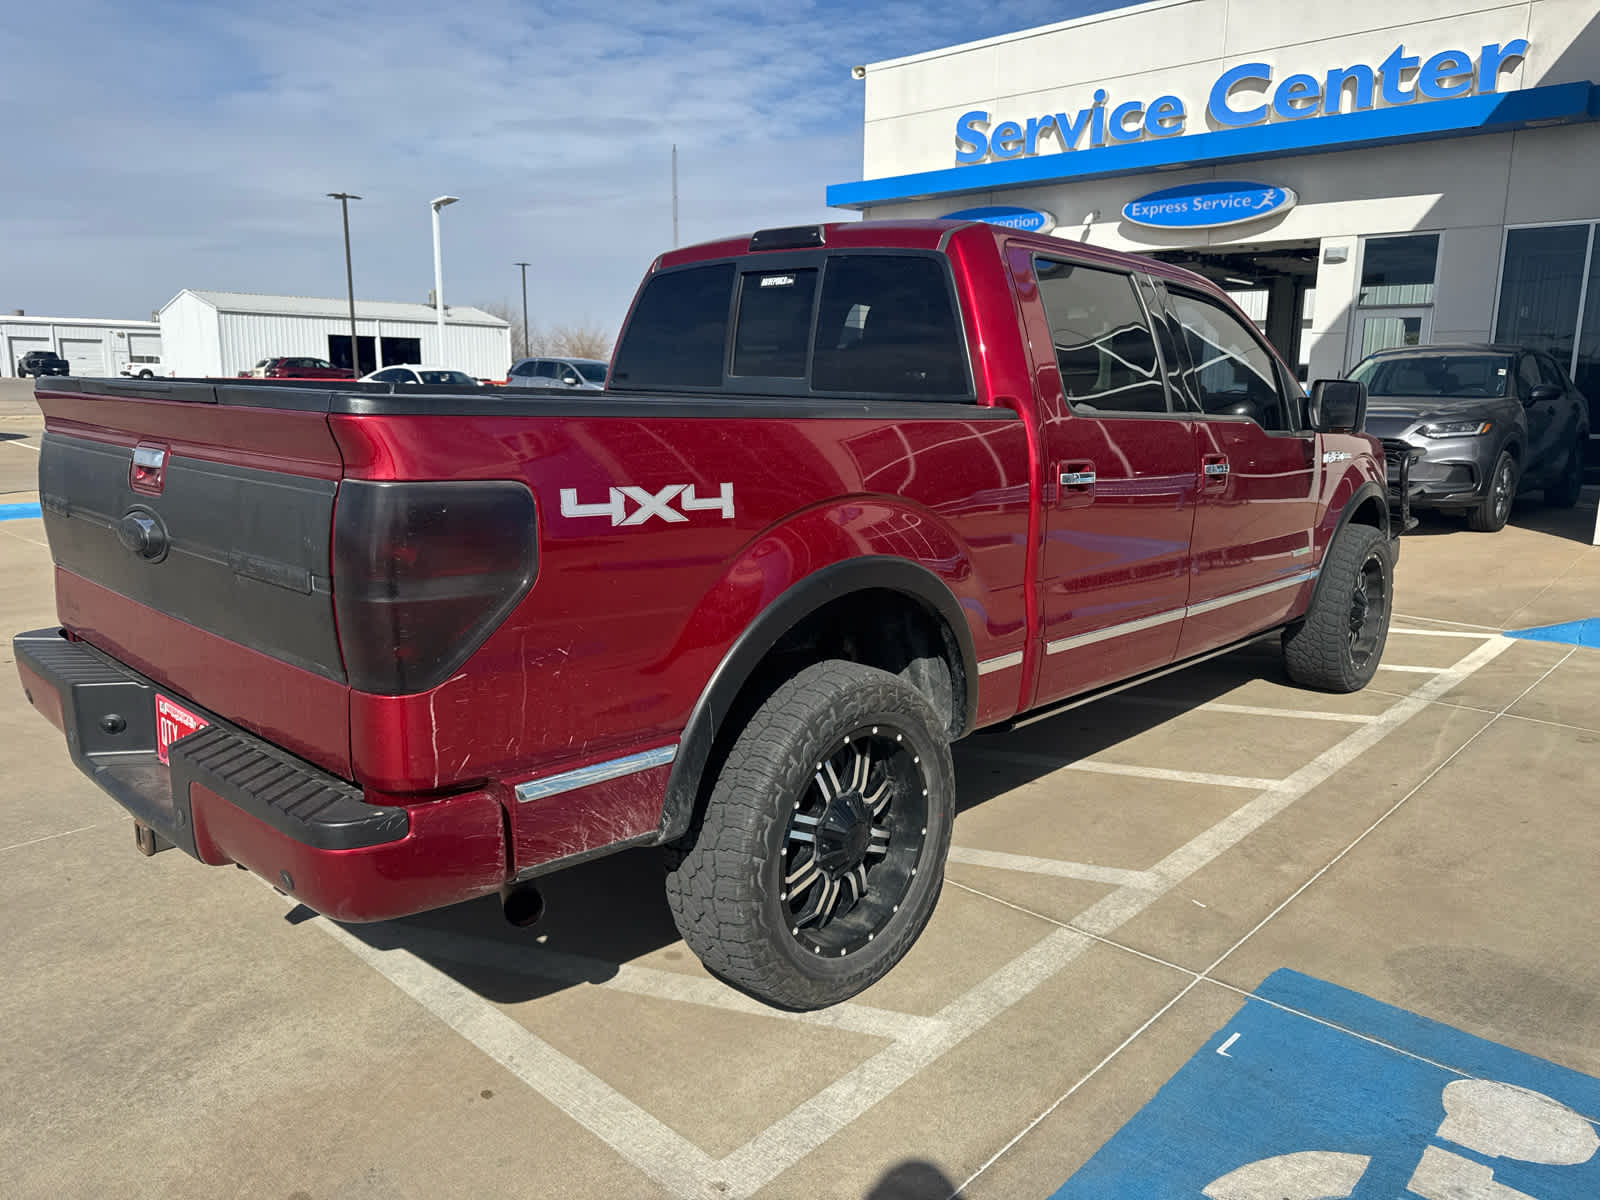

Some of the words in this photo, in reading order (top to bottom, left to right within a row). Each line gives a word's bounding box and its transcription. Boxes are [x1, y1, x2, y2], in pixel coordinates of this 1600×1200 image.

[956, 88, 1187, 163] Service
[1208, 38, 1531, 127] Center
[1132, 202, 1188, 219] Express
[1193, 195, 1251, 211] Service
